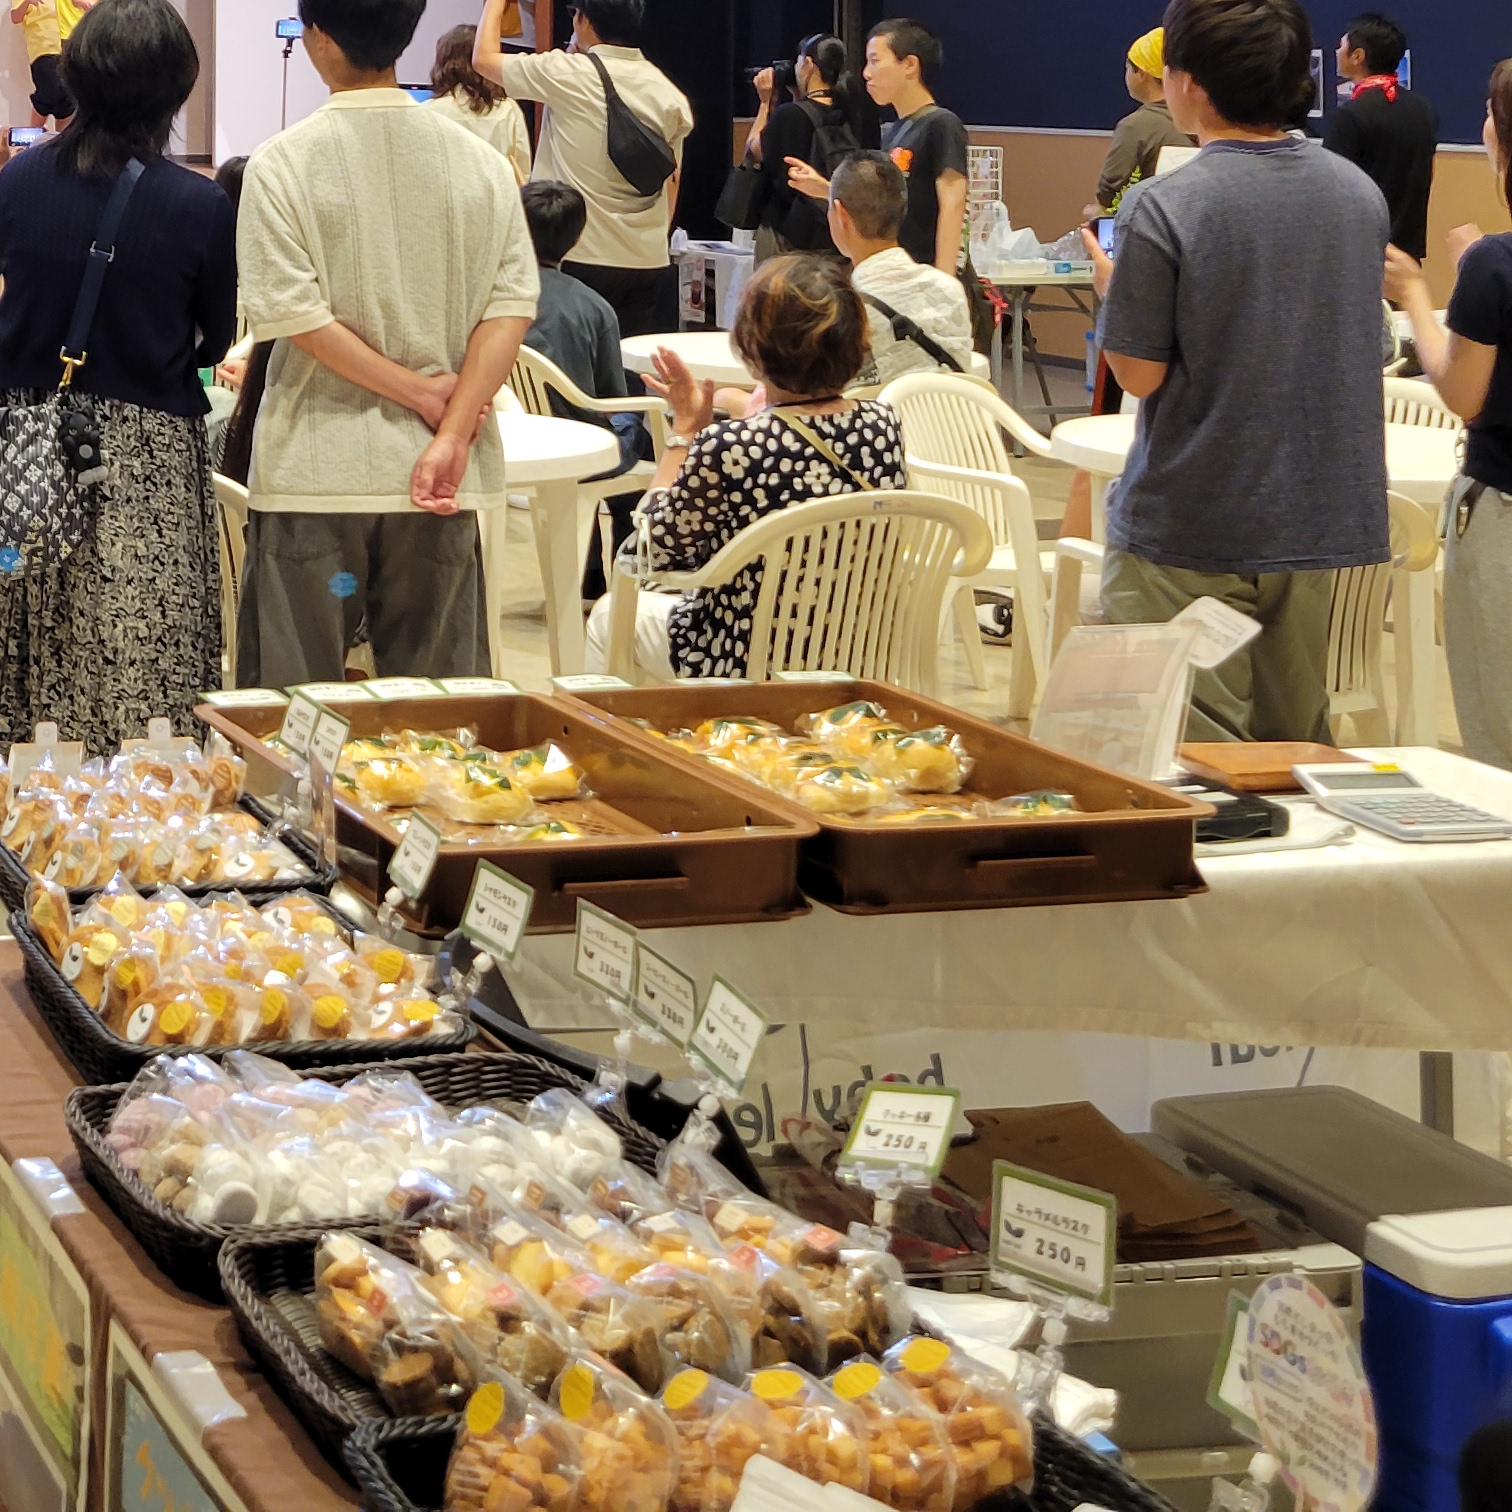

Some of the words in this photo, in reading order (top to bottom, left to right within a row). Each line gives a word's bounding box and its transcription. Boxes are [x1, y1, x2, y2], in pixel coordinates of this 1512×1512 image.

[487, 914, 509, 936] 150円
[1015, 1202, 1090, 1236] キャラメルラスク
[1034, 1238, 1086, 1272] 250円
